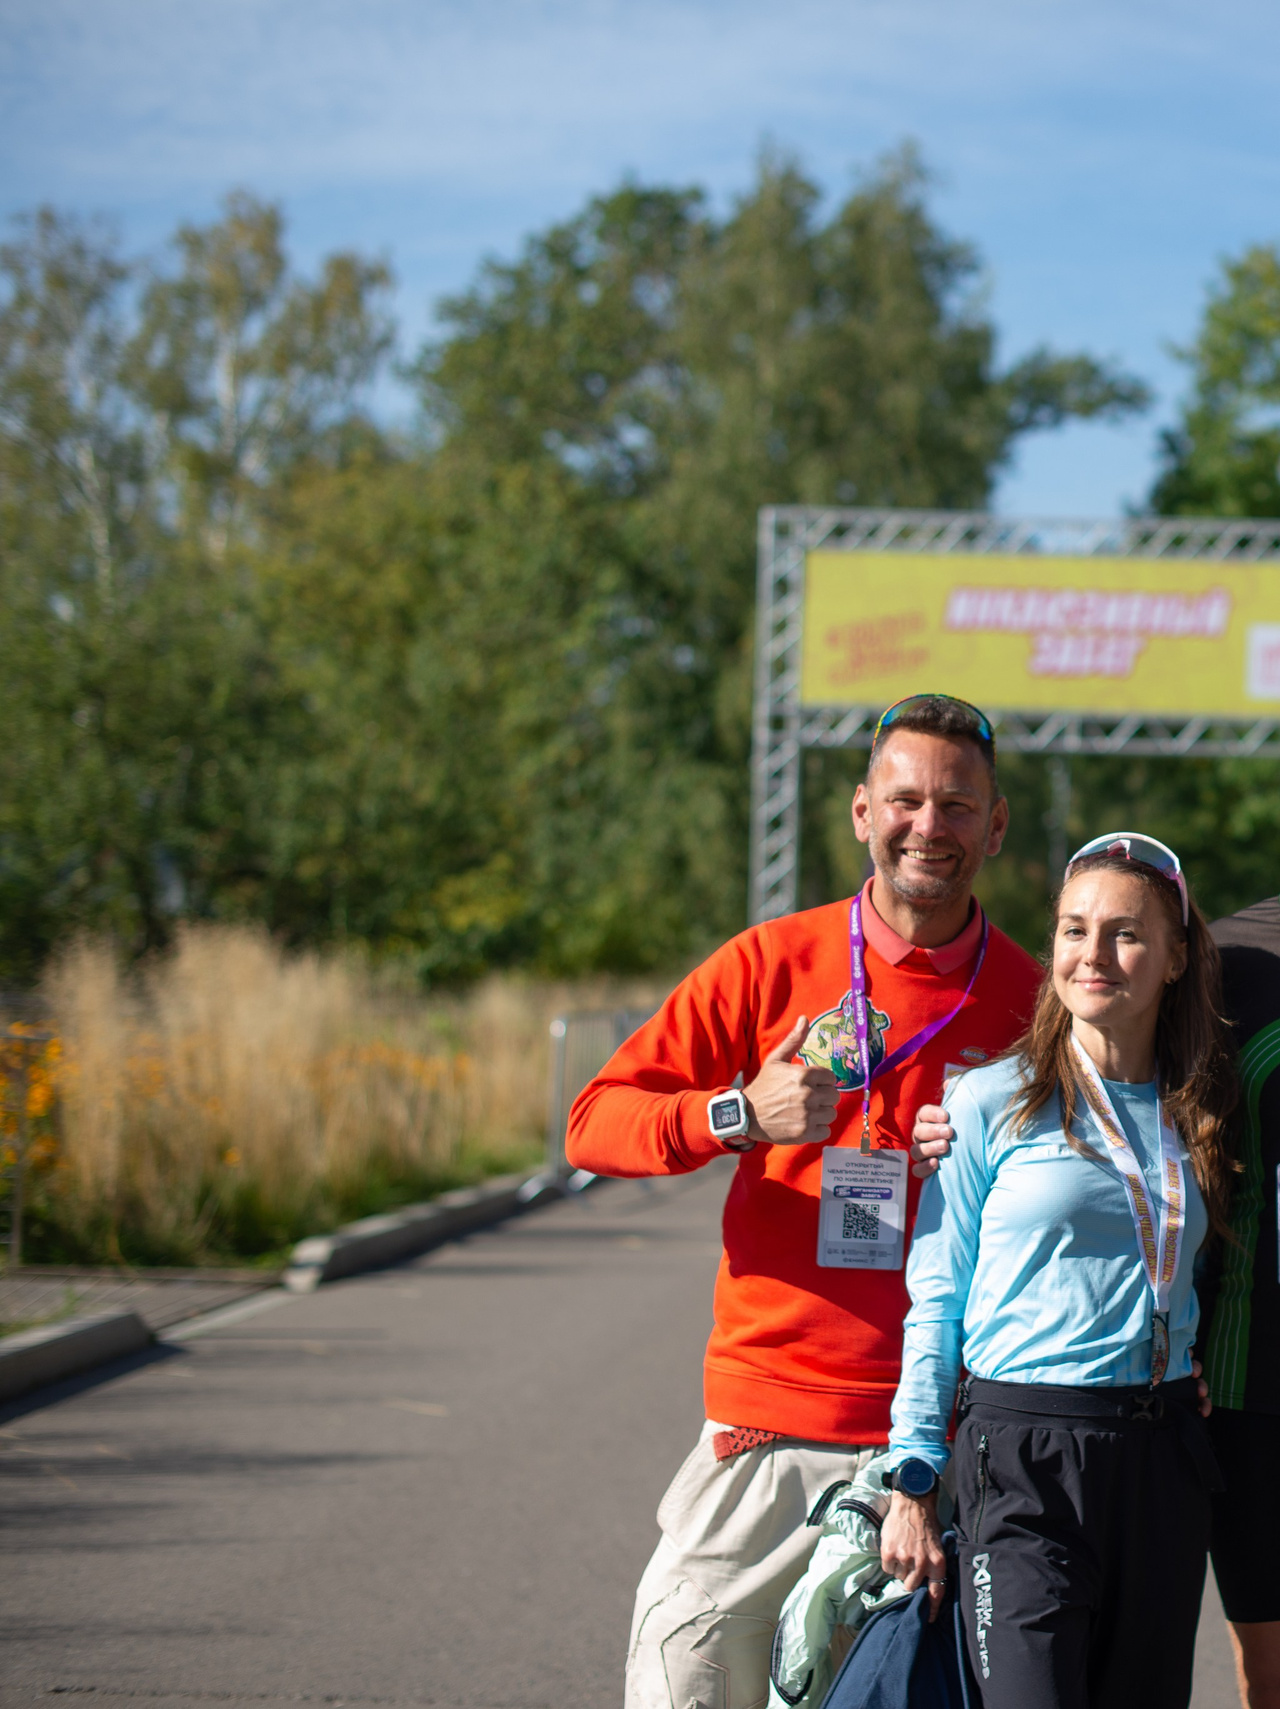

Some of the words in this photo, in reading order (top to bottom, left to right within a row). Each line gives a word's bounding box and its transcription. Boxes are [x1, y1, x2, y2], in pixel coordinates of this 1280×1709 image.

[851, 902, 859, 936] ФЕНИКС
[853, 945, 862, 979] ФЕНИКС
[855, 988, 865, 1026] ФЕНИКС
[1166, 1157, 1180, 1190] ЗАБЕГ
[1126, 1173, 1150, 1217] БОЛЬШЕ
[1139, 1216, 1154, 1240] ЧЕМ
[1162, 1191, 1181, 1283] ИНКЛЮЗИВНЫЙ
[981, 1585, 993, 1627] NEW
[975, 1588, 990, 1679] ATHLETICS
